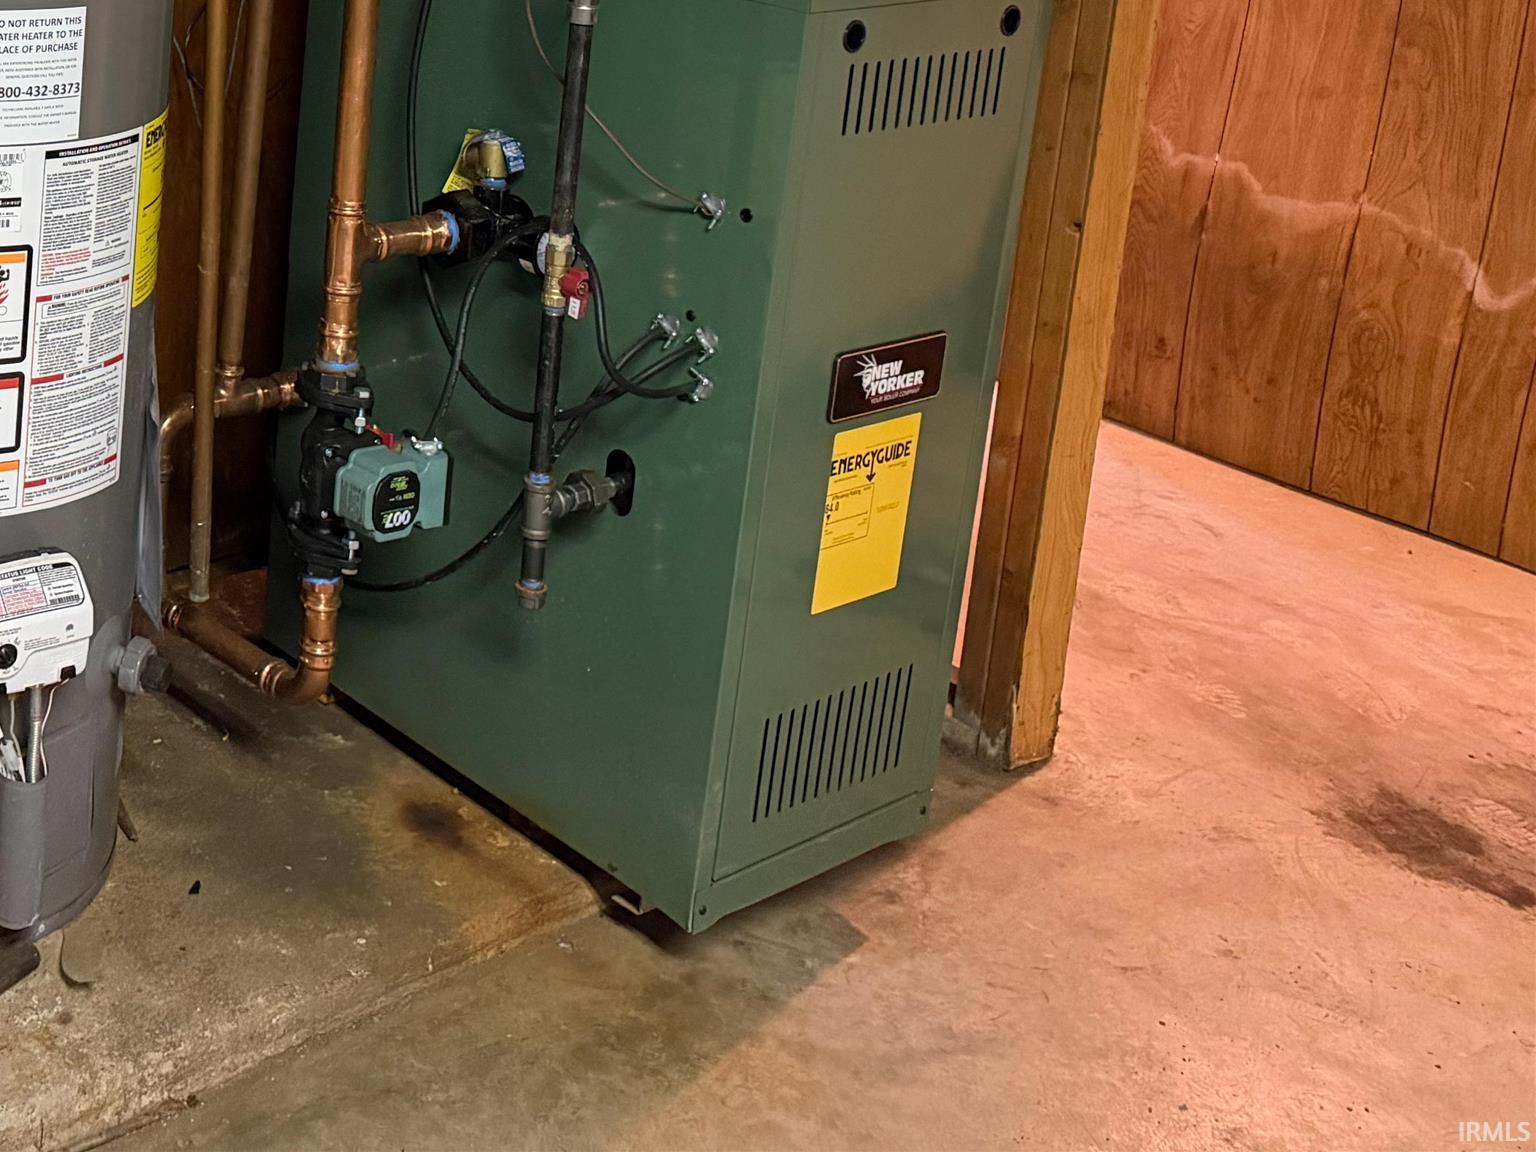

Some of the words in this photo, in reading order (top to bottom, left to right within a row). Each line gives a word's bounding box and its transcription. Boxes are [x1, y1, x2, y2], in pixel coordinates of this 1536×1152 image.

[8, 20, 28, 28] NOT
[29, 18, 62, 27] RETURN
[65, 16, 82, 24] THIS
[22, 31, 53, 40] HEATER
[56, 30, 66, 38] TO
[69, 29, 83, 37] THE
[22, 45, 33, 53] OF
[36, 42, 78, 53] PURCHASE
[871, 360, 903, 380] NEW
[870, 370, 924, 396] YORKER
[831, 440, 912, 477] ENERGYGUIDE
[19, 568, 36, 576] LIGHT
[37, 564, 53, 572] CODE
